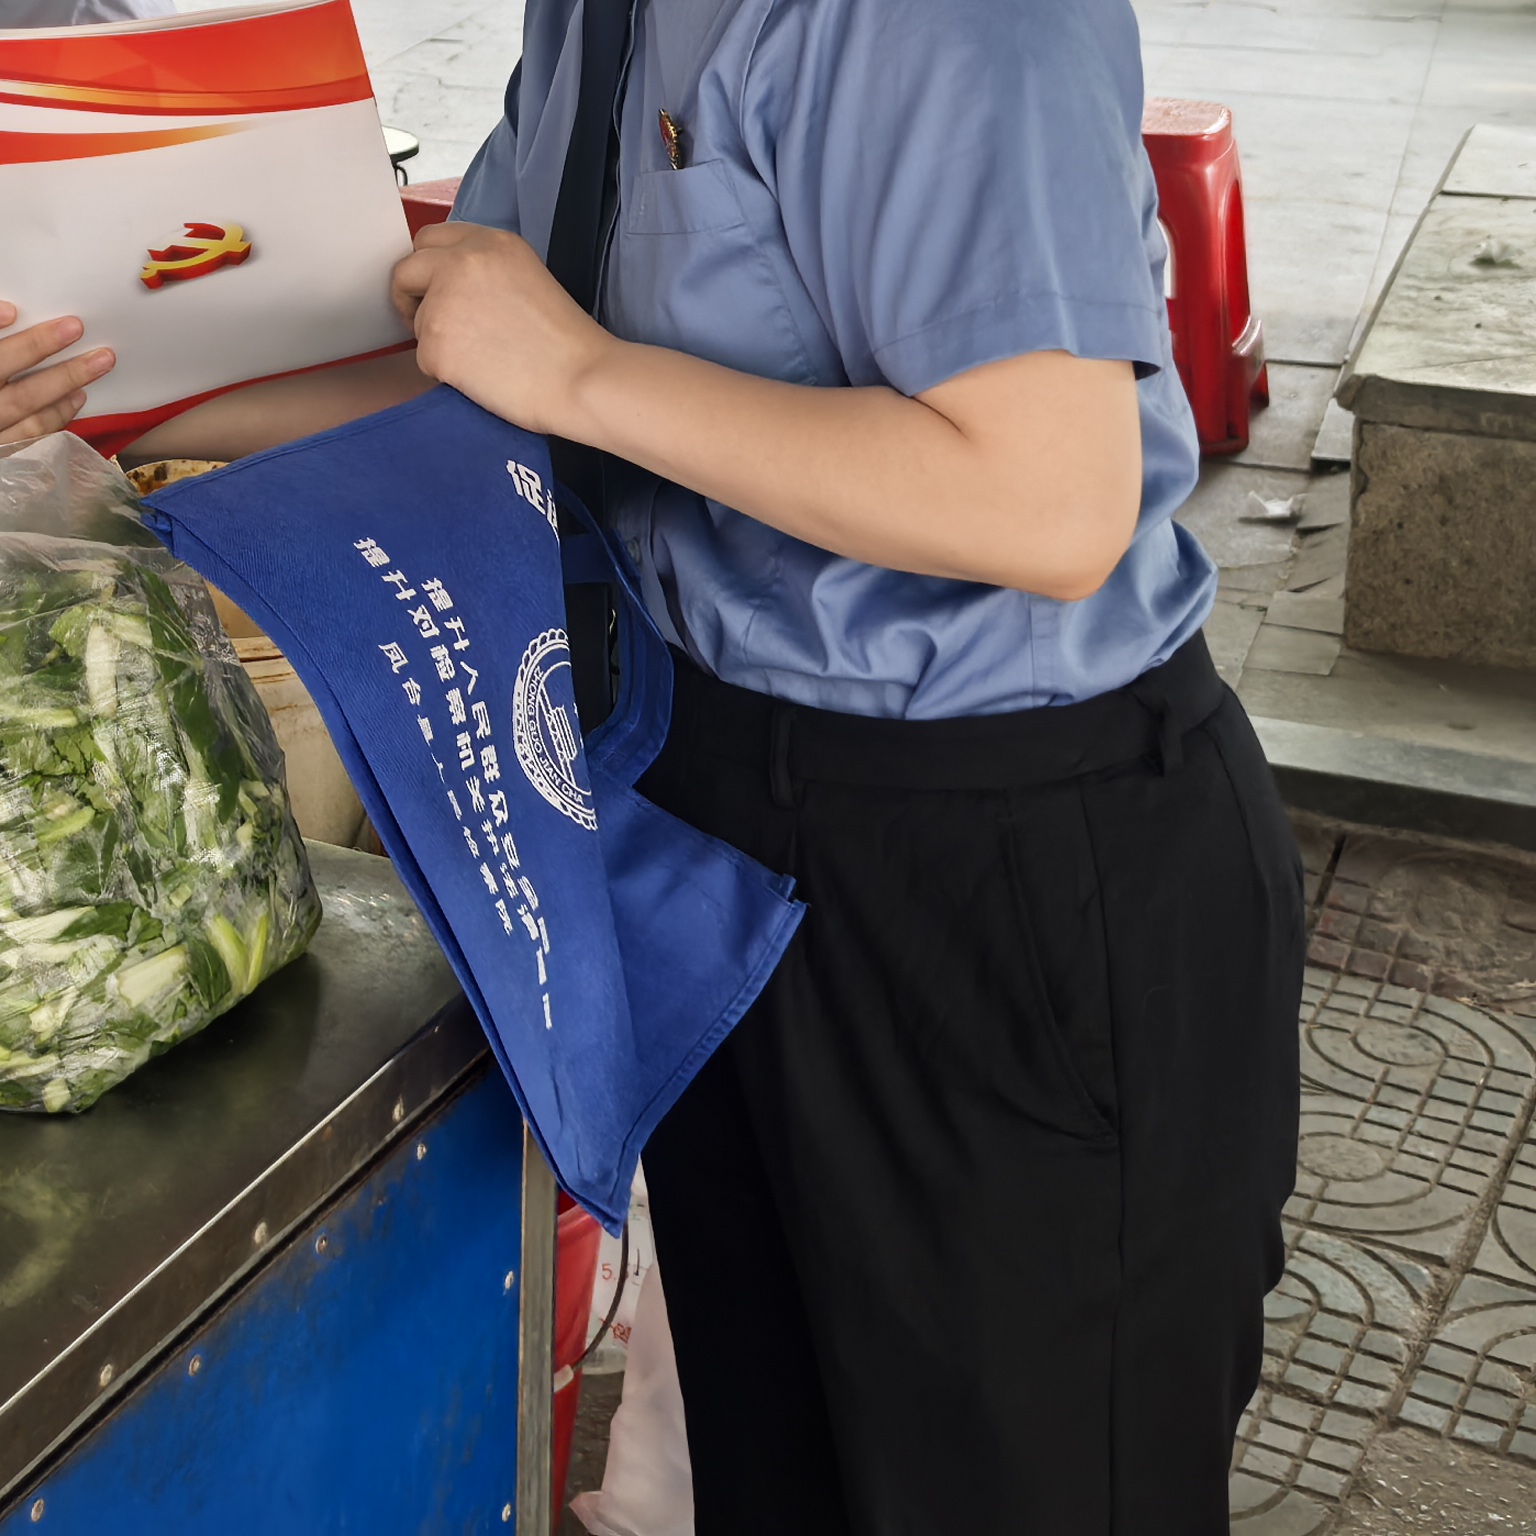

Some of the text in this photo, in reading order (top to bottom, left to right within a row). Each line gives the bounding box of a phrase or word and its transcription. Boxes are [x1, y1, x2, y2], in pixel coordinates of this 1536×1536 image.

[528, 719, 543, 755] GUO
[539, 756, 562, 789] JIAN
[560, 782, 586, 806] CHA
